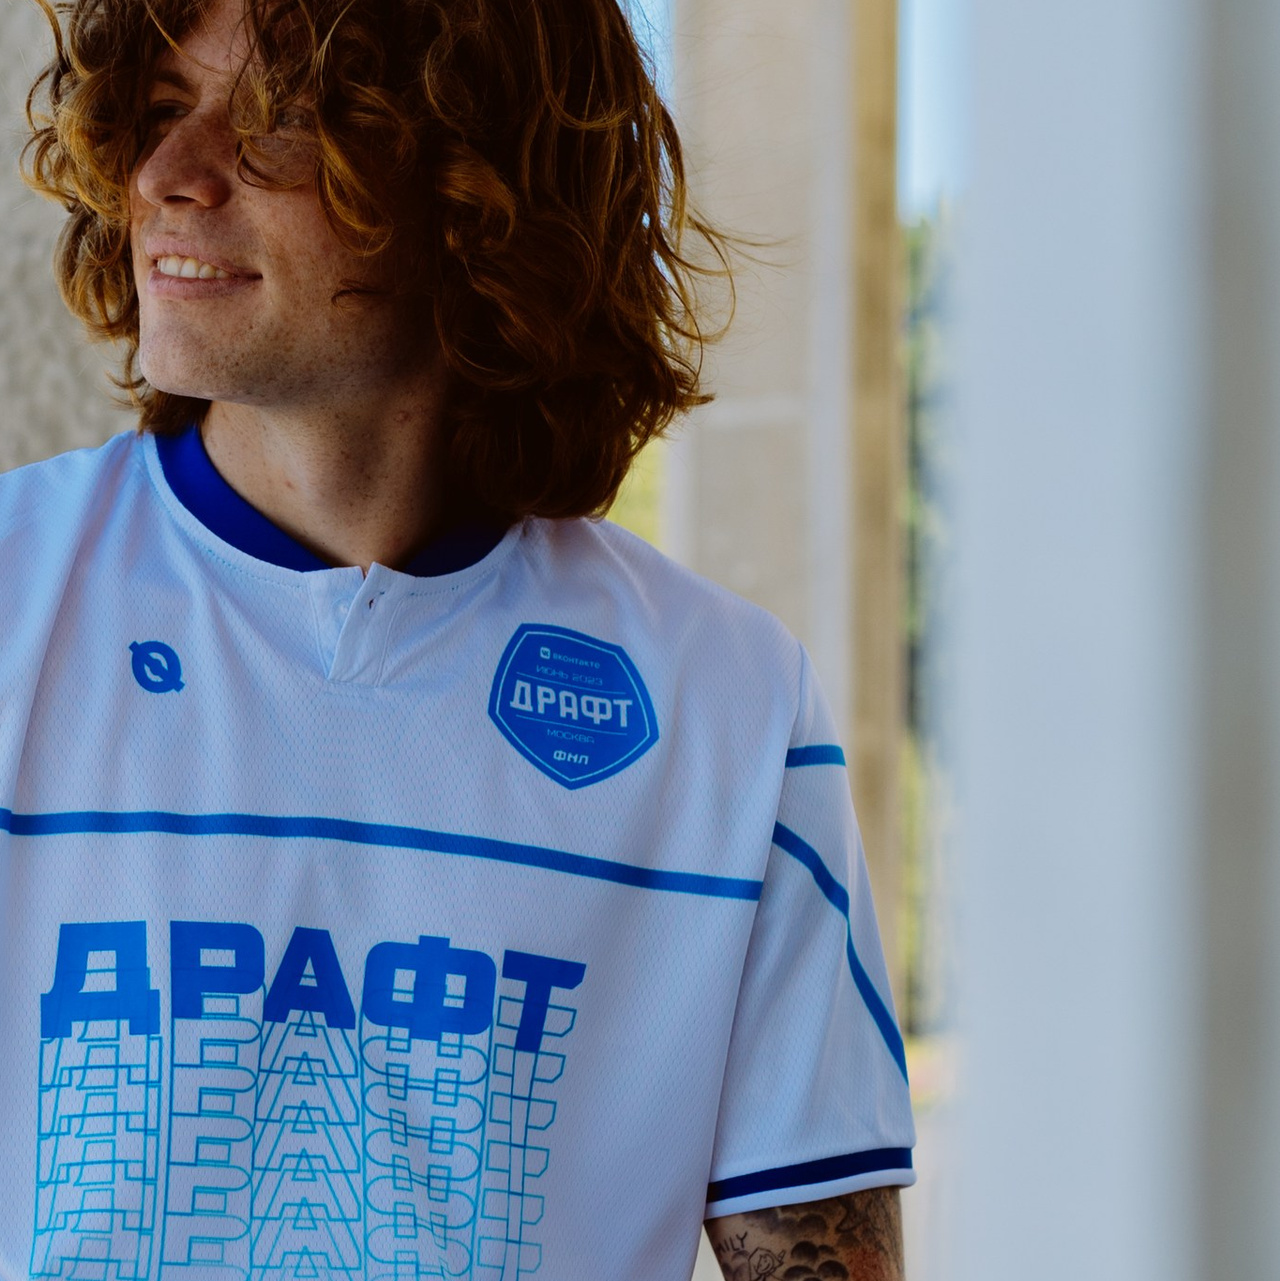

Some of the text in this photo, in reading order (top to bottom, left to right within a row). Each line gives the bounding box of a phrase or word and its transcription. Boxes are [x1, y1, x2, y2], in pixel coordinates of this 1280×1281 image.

[510, 679, 633, 728] ДРАФТ
[547, 728, 595, 744] МОСКВА
[553, 750, 589, 765] ФНЛ
[40, 920, 587, 1054] ДРАФТ
